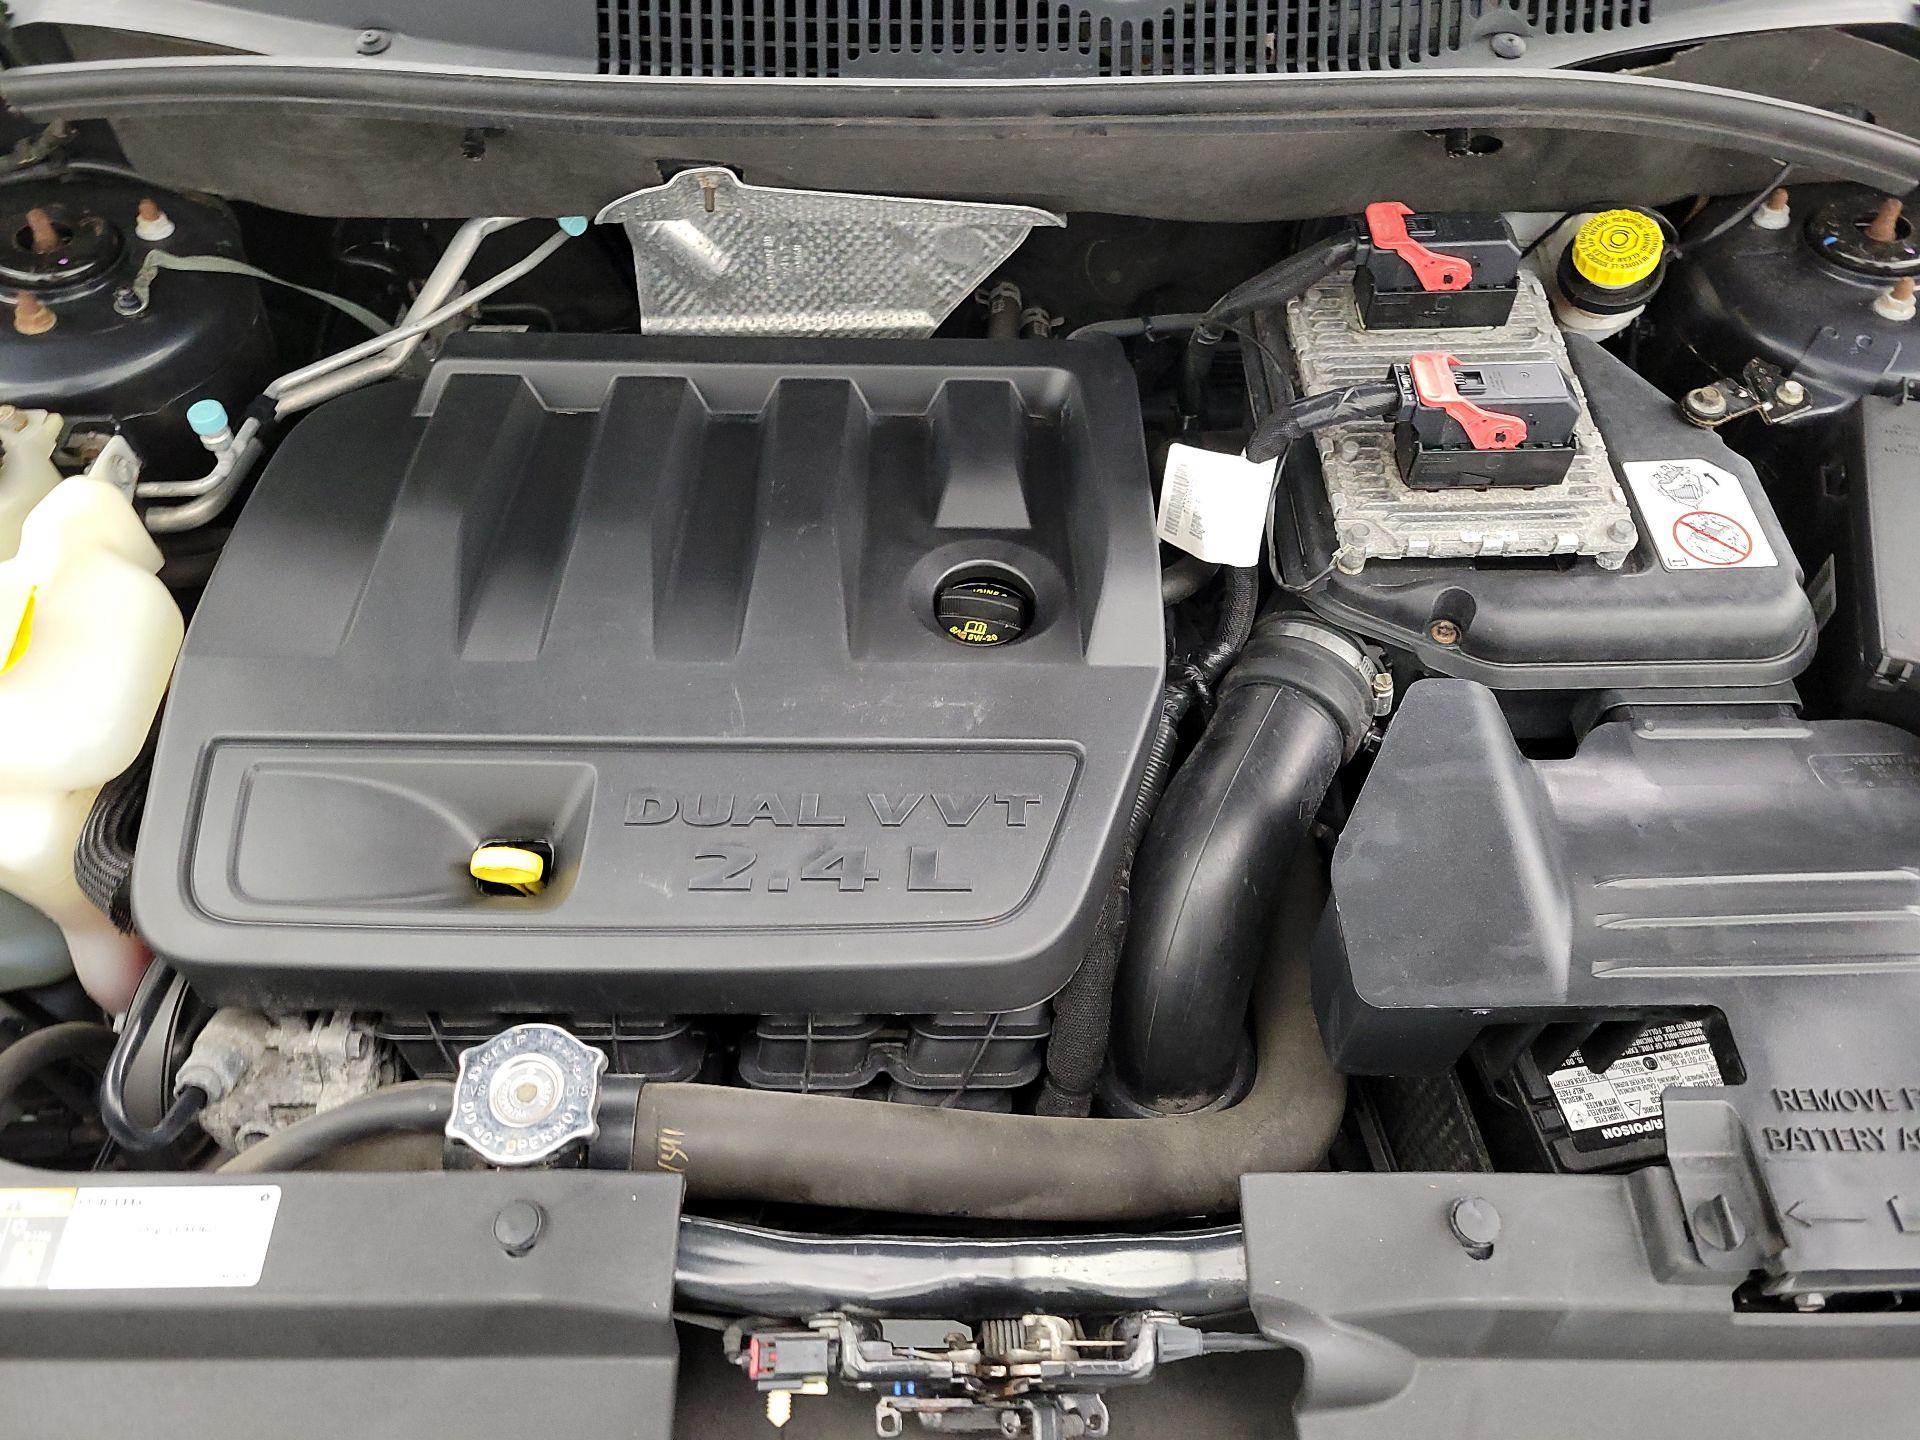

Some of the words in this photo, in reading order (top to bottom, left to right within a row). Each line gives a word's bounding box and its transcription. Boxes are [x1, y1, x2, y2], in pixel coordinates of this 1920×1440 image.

[623, 792, 847, 828] DUAL
[867, 792, 1042, 828] VVT
[1663, 1041, 1677, 1049] RISK
[1677, 1034, 1707, 1045] WARNING:
[1572, 1086, 1585, 1094] HELP
[1559, 1095, 1582, 1105] MEDICAL
[1601, 1098, 1617, 1106] WITH
[1770, 1087, 1899, 1112] REMOVE
[1586, 1106, 1621, 1117] IMMEDIATELY
[1608, 1112, 1624, 1121] FLUSH
[1593, 1115, 1607, 1123] EYES
[1601, 1118, 1663, 1139] R/POISON
[505, 1131, 553, 1153] OPEN
[1762, 1126, 1887, 1152] BATTERY
